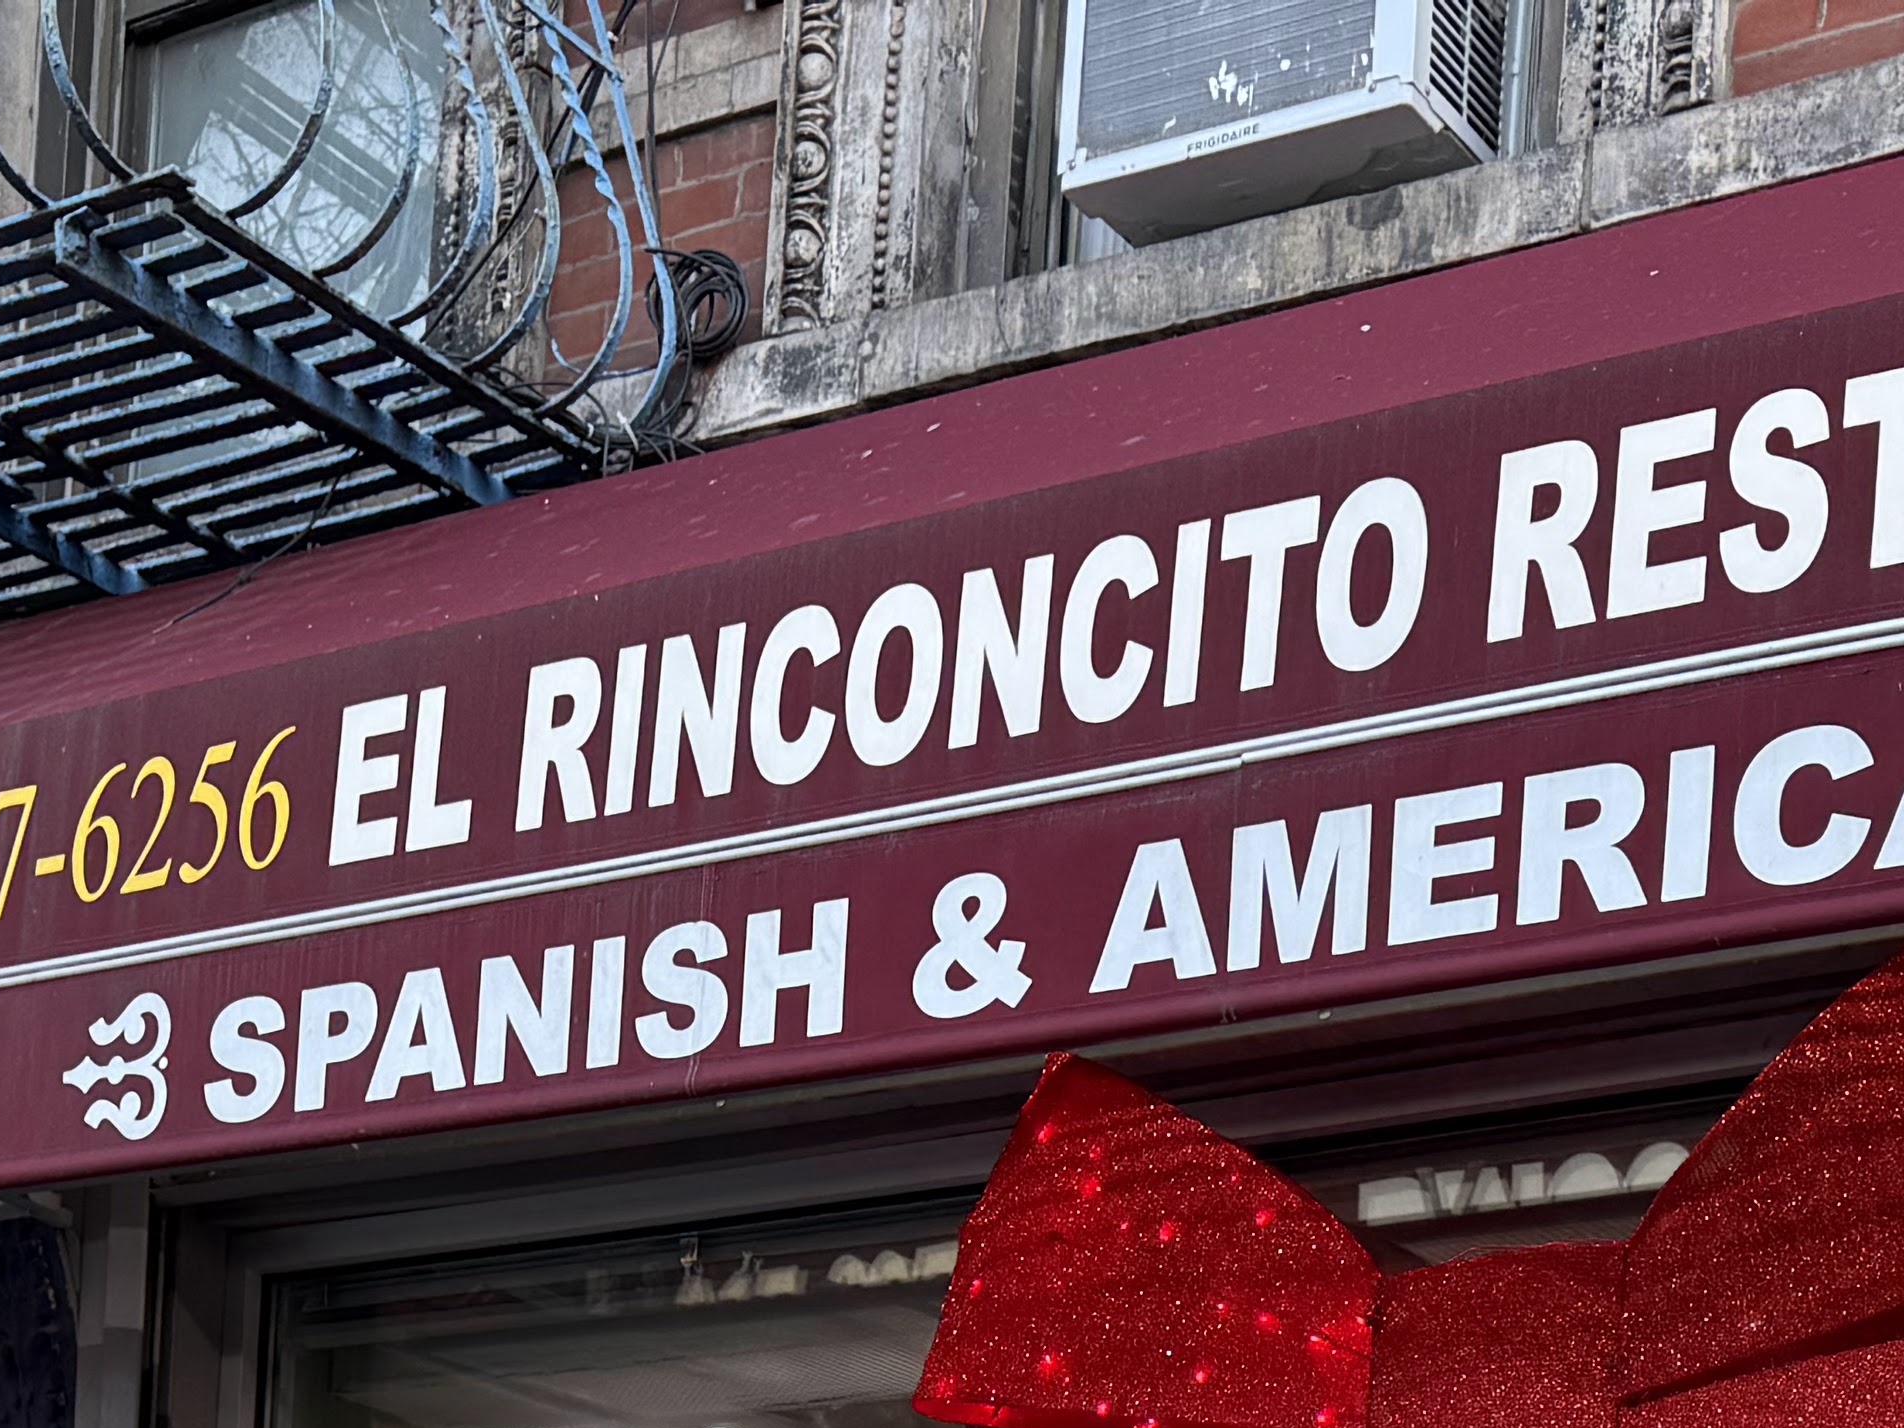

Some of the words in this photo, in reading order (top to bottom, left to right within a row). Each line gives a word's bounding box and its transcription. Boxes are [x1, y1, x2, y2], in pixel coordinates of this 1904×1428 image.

[1187, 123, 1260, 153] FRIGIDAIRE
[329, 685, 473, 867] EL
[514, 476, 1429, 834] RINCONCITO
[203, 896, 850, 1123] SPANISH
[912, 871, 1033, 1020] &
